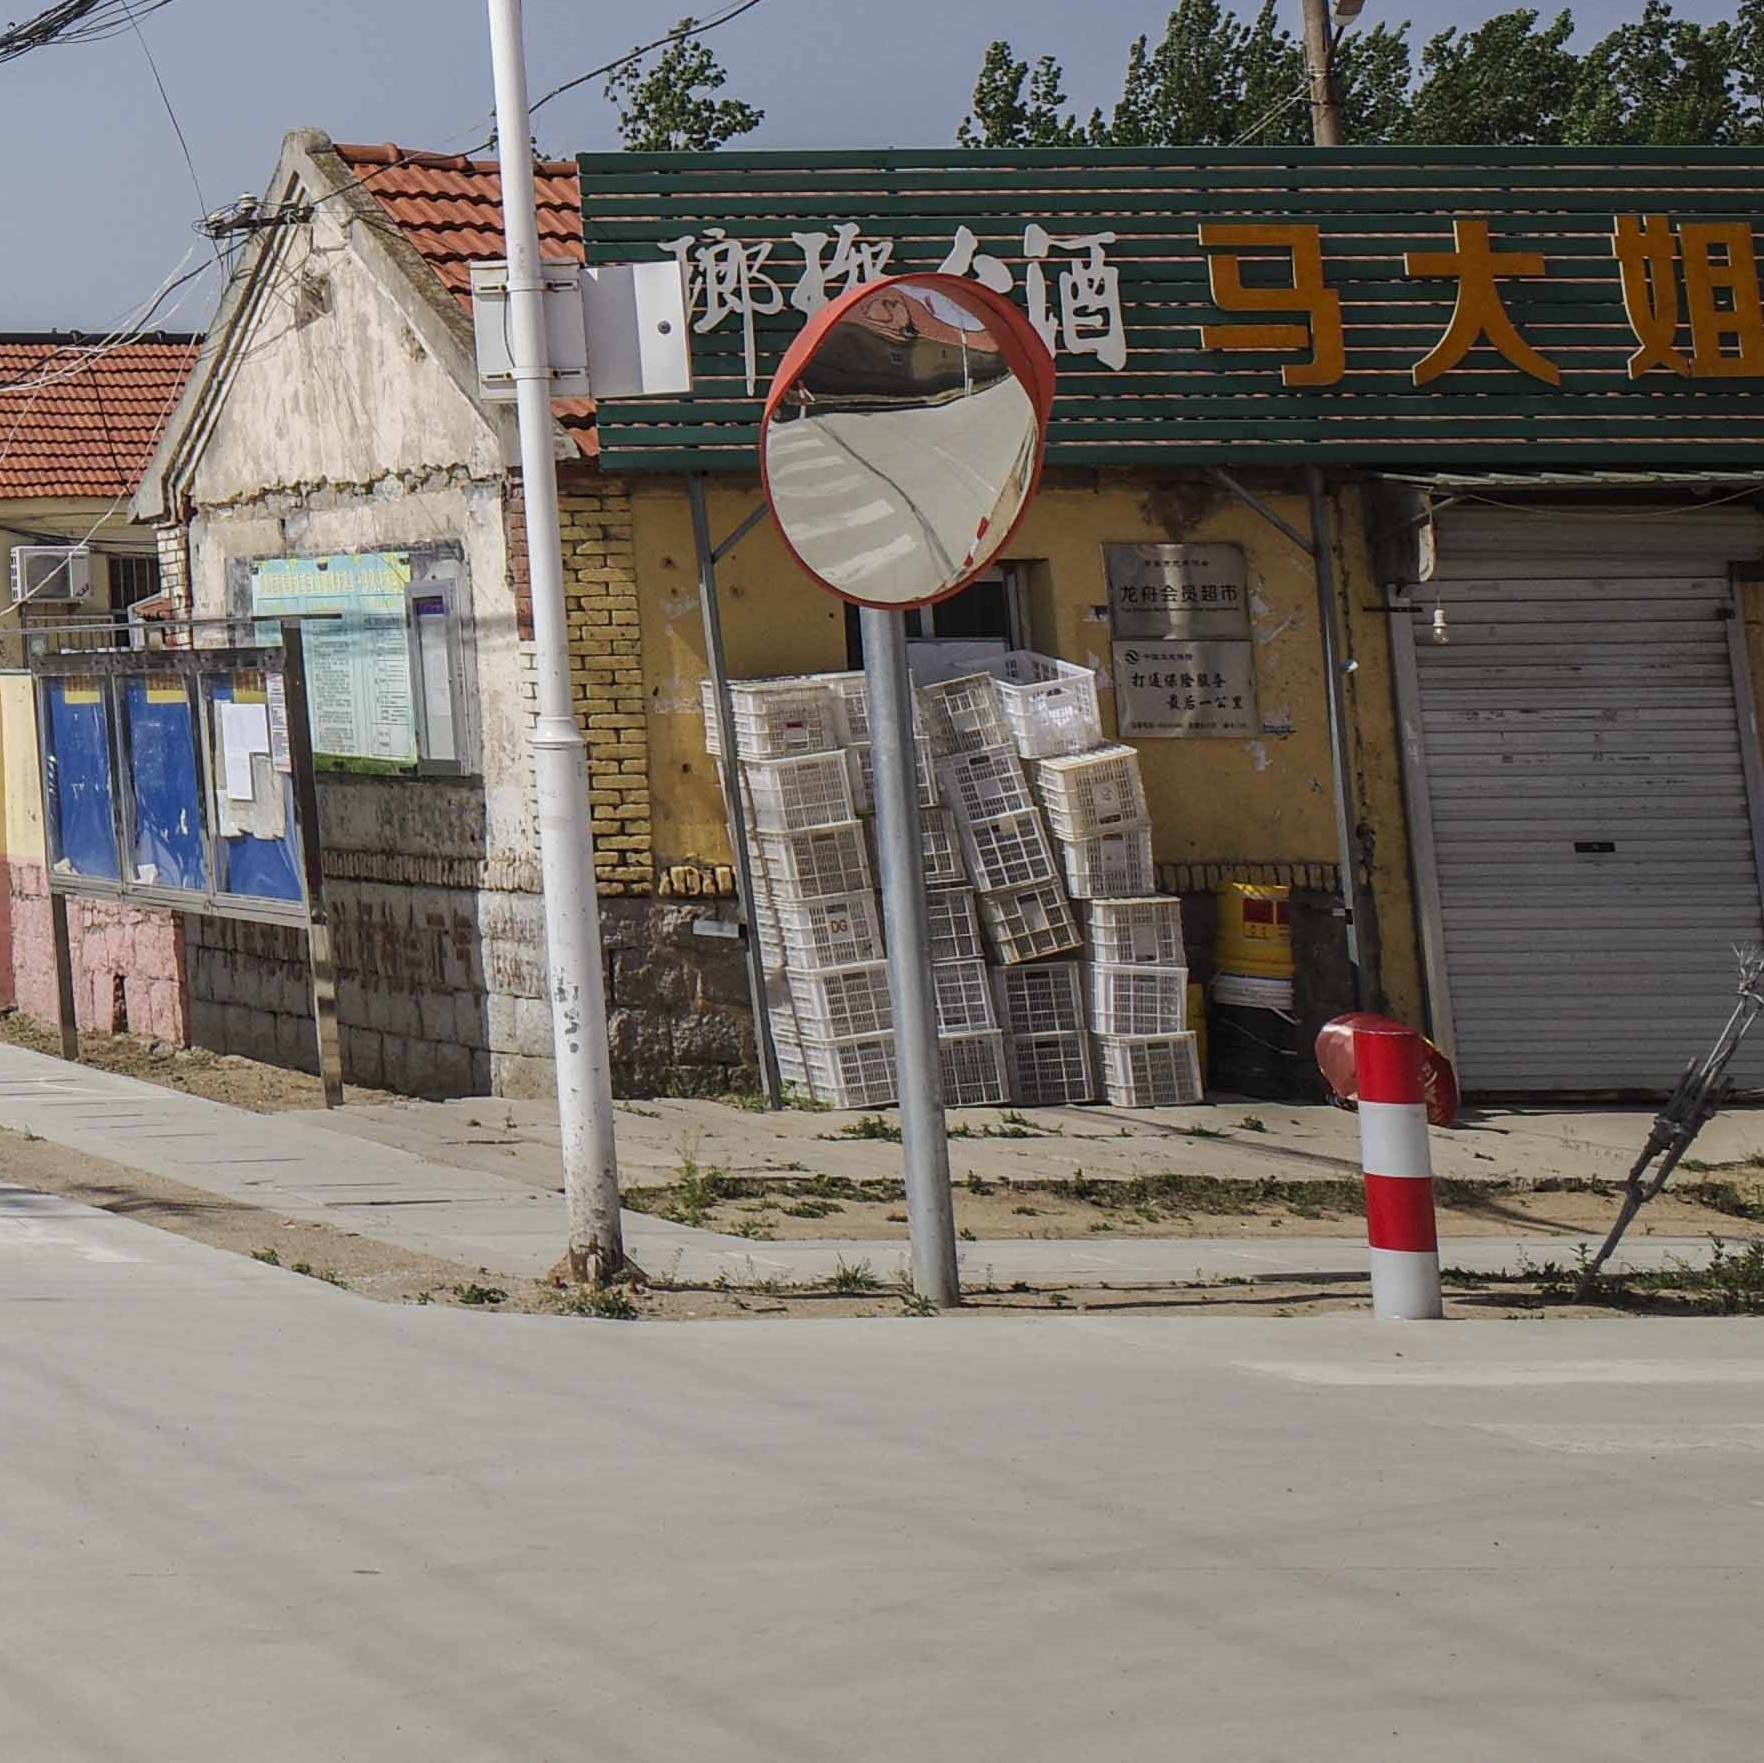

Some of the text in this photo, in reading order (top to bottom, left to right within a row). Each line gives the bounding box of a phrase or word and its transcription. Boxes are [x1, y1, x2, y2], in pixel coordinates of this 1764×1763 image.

[1198, 215, 1764, 387] 马大姐
[1121, 585, 1238, 603] 龙舟会员超市
[1132, 672, 1226, 688] 打通保险服务
[1166, 695, 1243, 710] 最后一公里
[830, 919, 848, 933] DG
